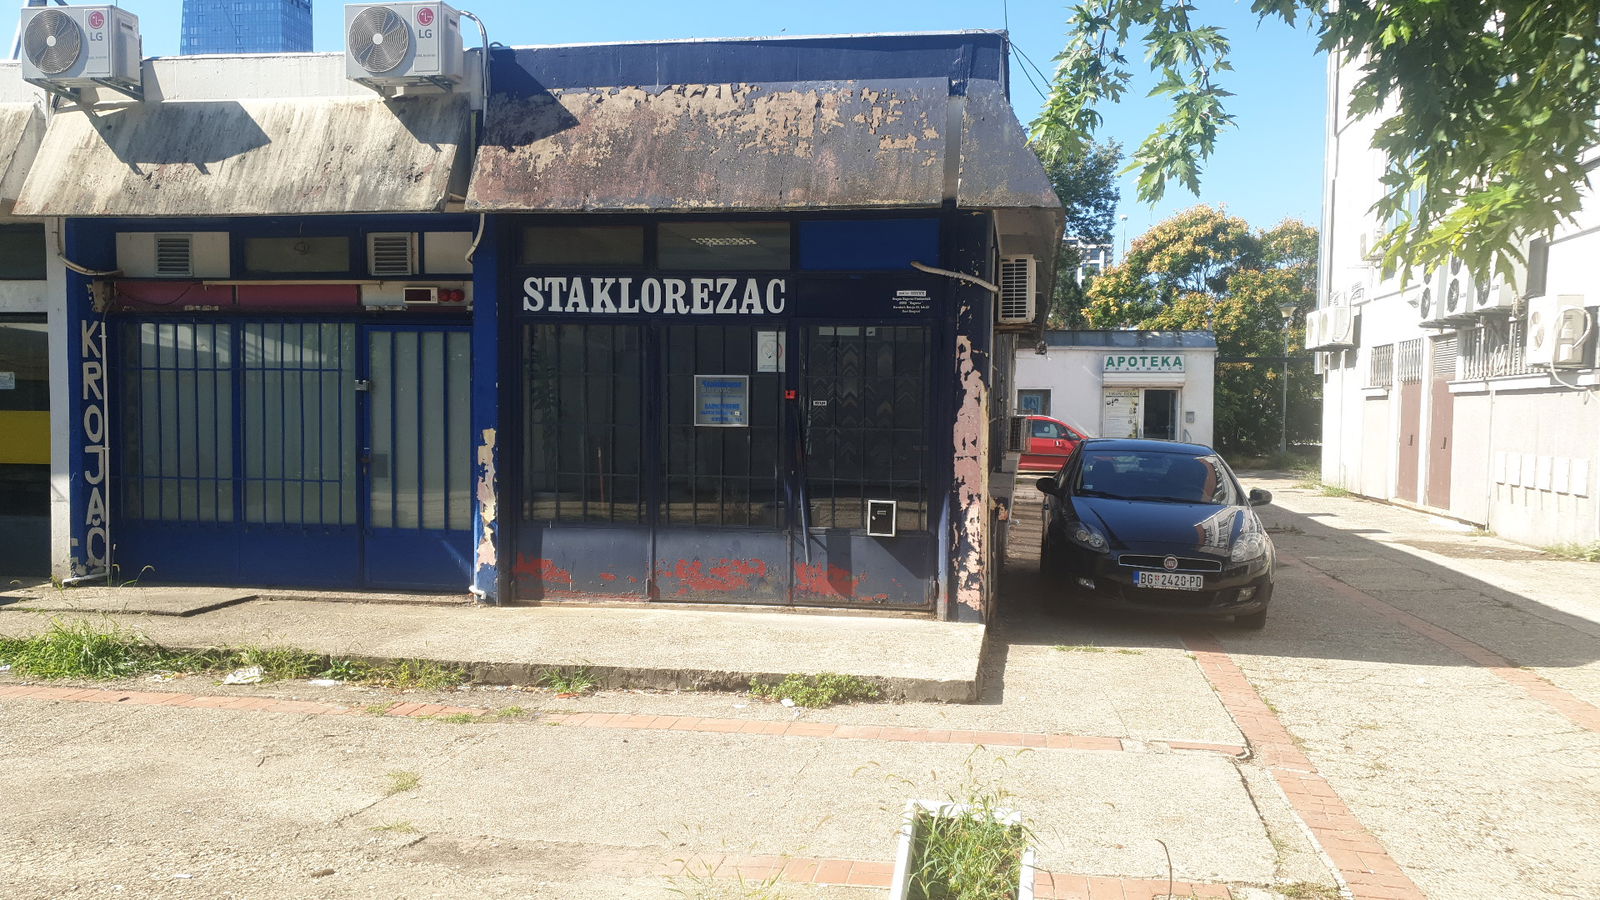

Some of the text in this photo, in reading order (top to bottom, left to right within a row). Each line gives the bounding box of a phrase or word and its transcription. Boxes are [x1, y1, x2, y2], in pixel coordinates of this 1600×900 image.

[90, 32, 103, 41] LG
[418, 29, 433, 39] LG
[522, 276, 786, 315] STAKLOREZAC
[1105, 356, 1183, 367] APOTEKA
[1140, 572, 1202, 587] BG 2420-PD
